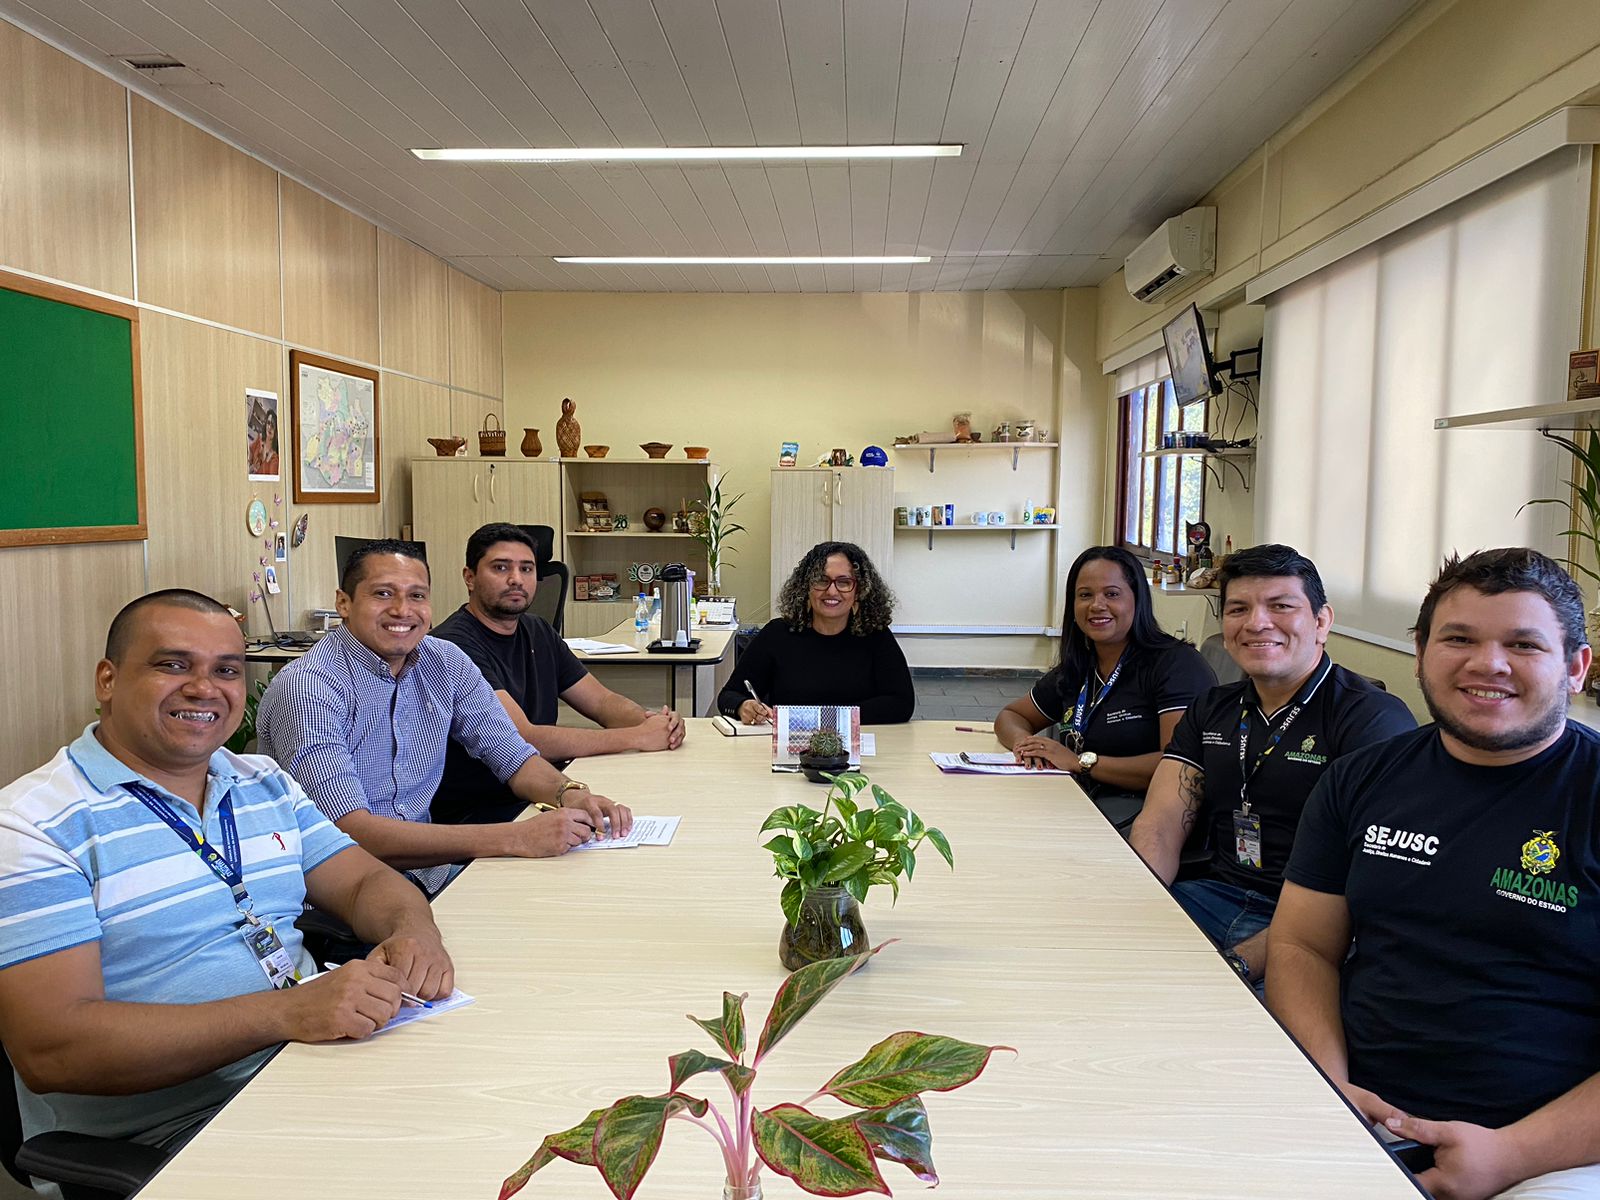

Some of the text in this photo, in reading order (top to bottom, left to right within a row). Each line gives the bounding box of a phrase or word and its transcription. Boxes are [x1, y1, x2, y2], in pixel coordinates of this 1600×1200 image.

[614, 518, 628, 529] 20
[1074, 704, 1084, 727] SEJUSC
[1279, 705, 1301, 732] SEJUSC
[1239, 734, 1248, 760] SEJUSC
[1284, 751, 1327, 763] AMAZONAS
[1364, 824, 1440, 856] SEJUSC
[1489, 867, 1579, 908] AMAZONAS
[1495, 889, 1567, 913] GOVERNO DO ESTADO
